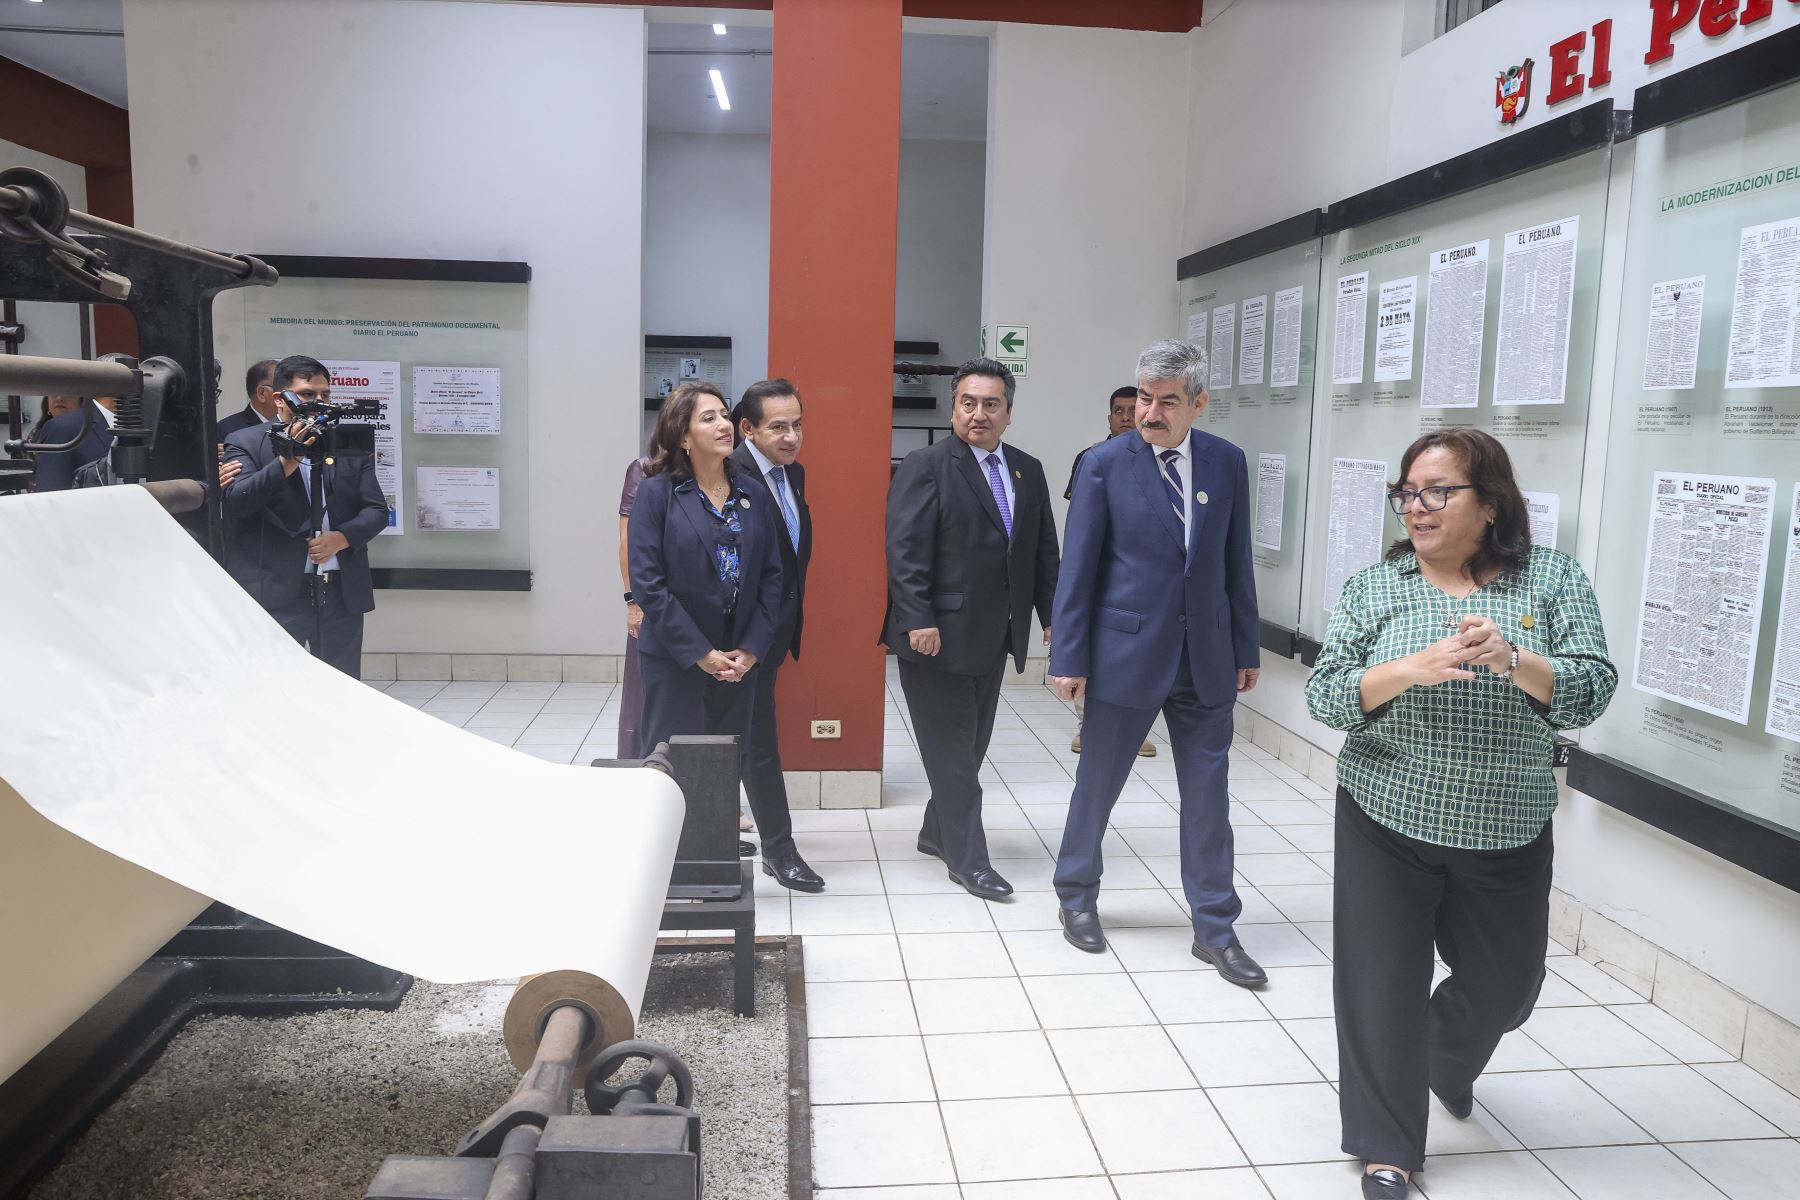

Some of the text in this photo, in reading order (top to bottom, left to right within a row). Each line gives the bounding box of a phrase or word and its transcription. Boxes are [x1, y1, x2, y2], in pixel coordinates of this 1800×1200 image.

[1546, 0, 1800, 105] El Per
[1661, 166, 1800, 212] LA MODERNIZACION DEL
[1519, 234, 1526, 244] EL
[1761, 226, 1800, 242] EL PERUA
[1346, 250, 1369, 264] SEGUNDA
[1369, 246, 1384, 258] MITAD
[1384, 243, 1395, 254] DEL
[1395, 238, 1411, 250] SIGLO
[1440, 253, 1447, 264] EL
[1666, 280, 1704, 292] PERUANO
[346, 319, 397, 328] PRESERVACIÓN
[328, 376, 369, 386] ruano
[1683, 481, 1694, 491] EL
[1696, 482, 1740, 495] PERUANO
